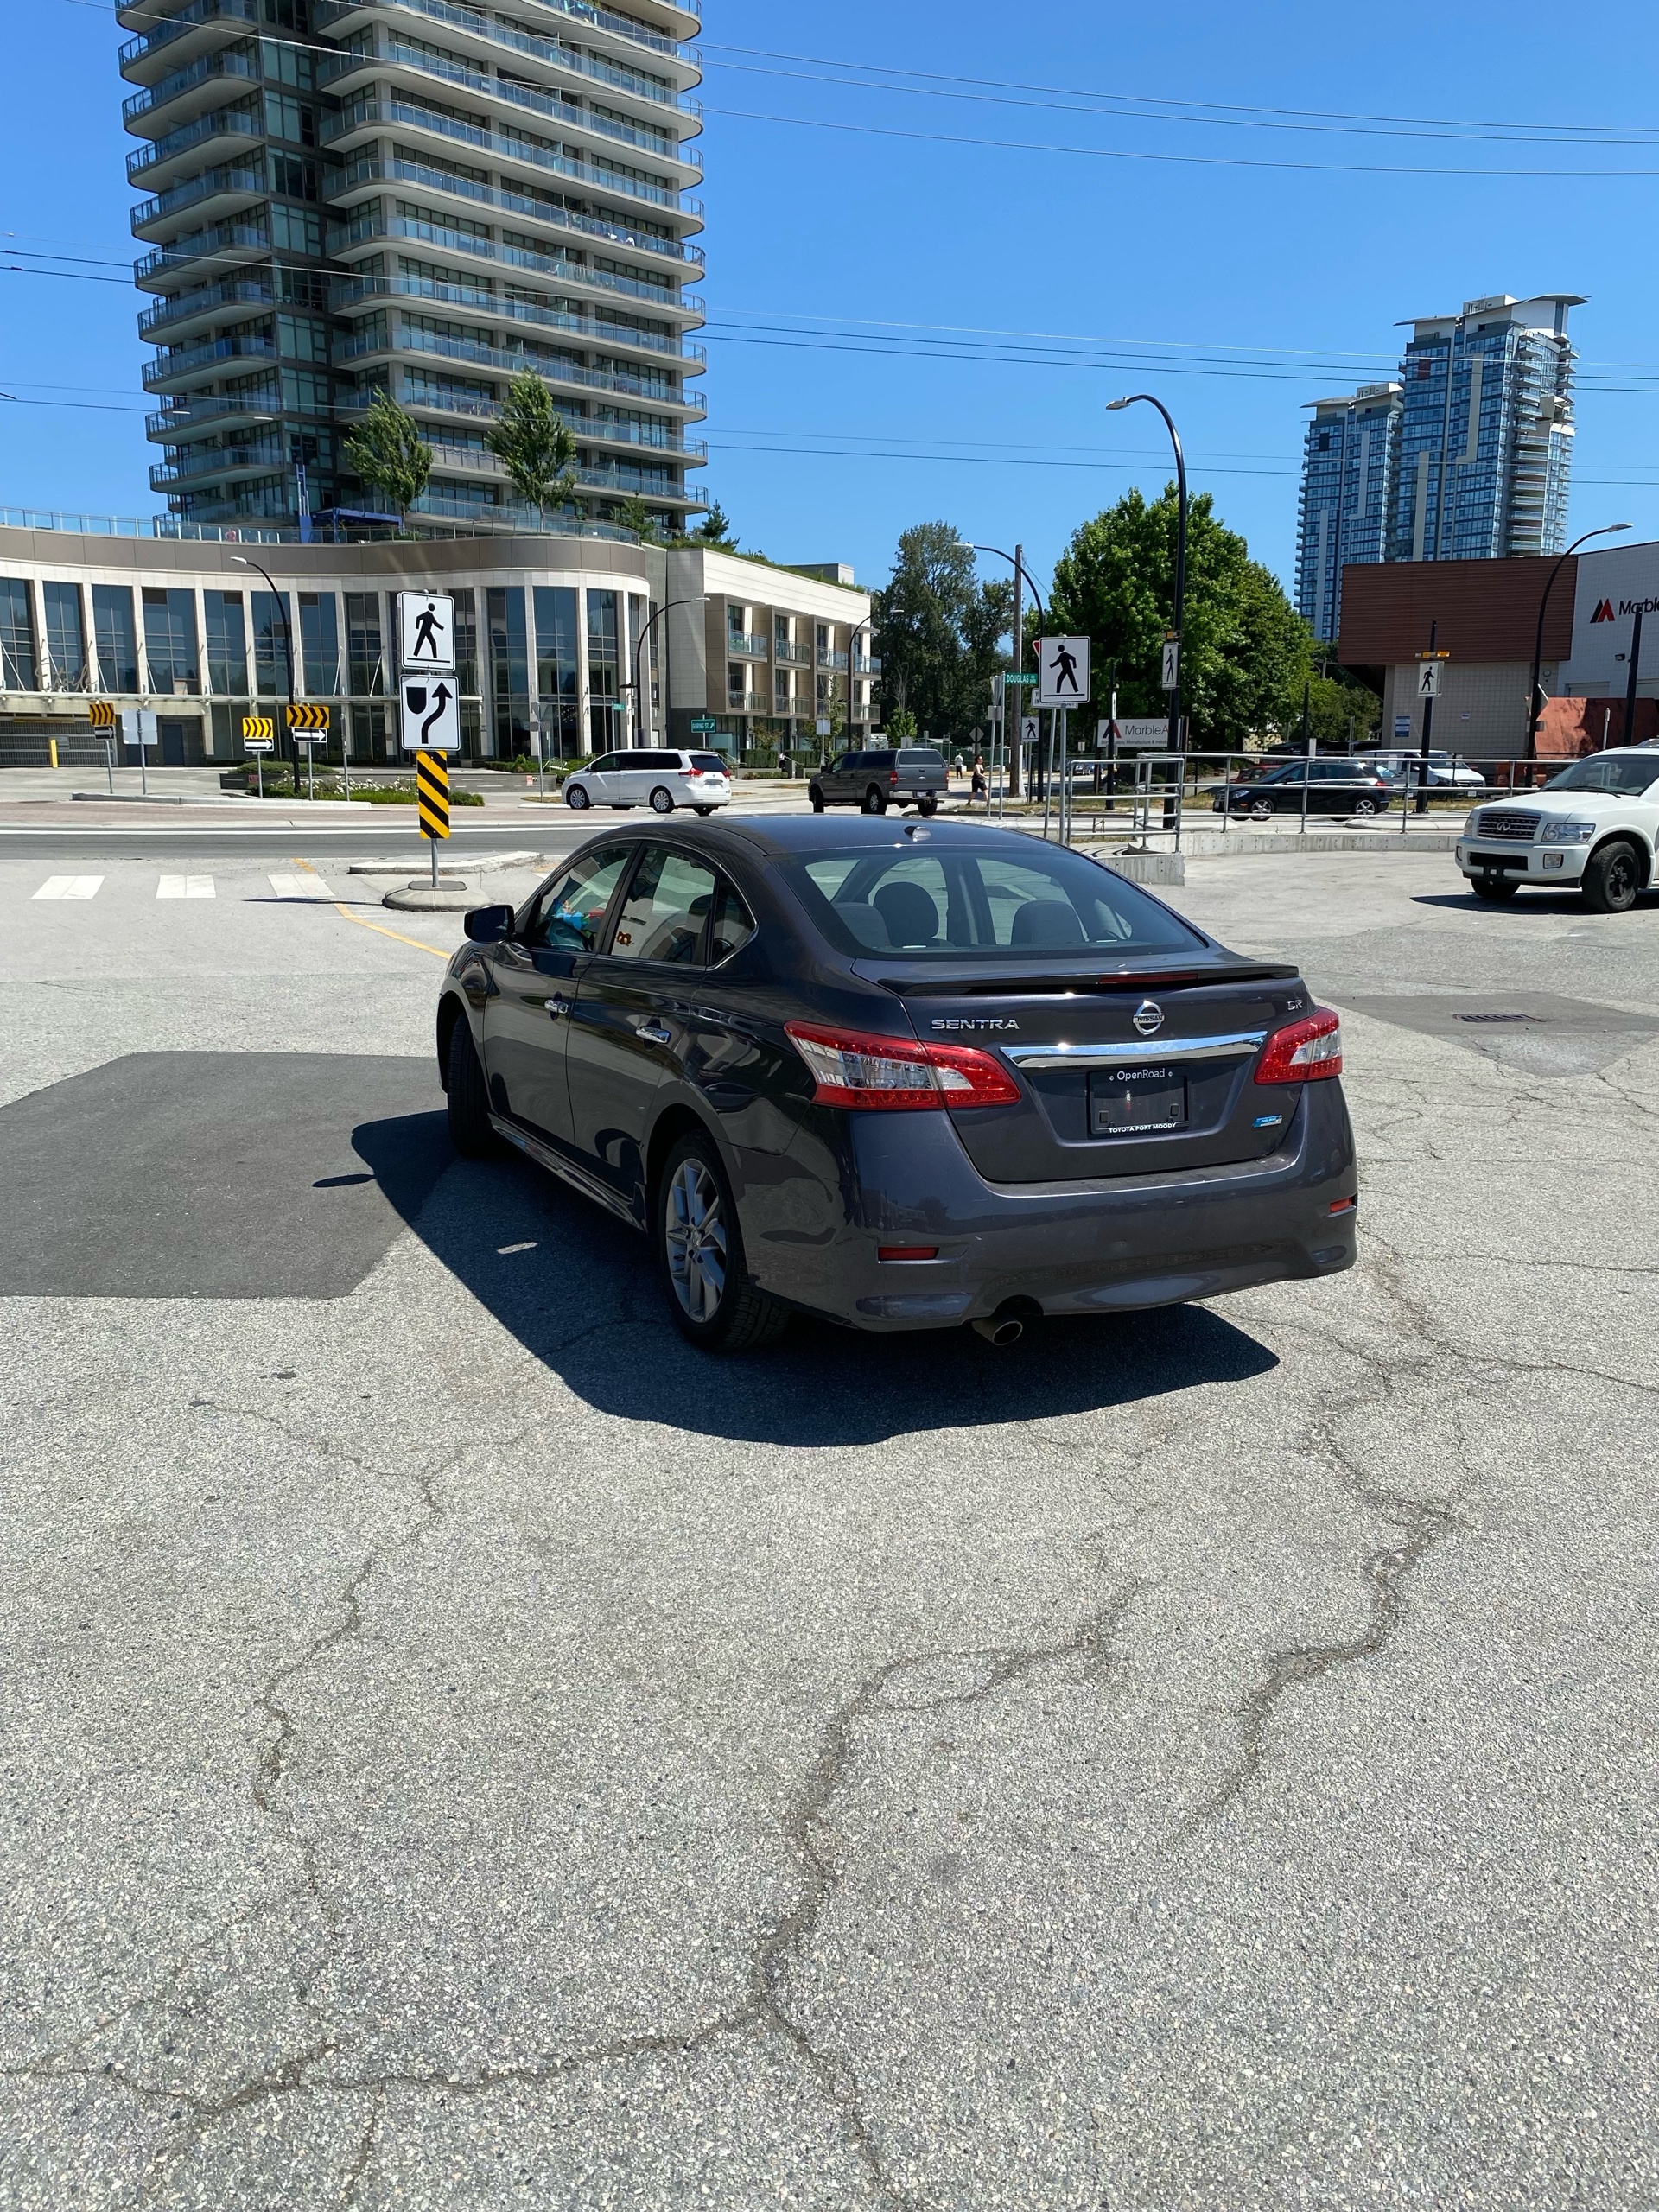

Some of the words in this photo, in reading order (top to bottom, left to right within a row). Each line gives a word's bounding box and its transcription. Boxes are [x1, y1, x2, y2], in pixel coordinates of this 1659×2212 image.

[1007, 674, 1029, 683] DOUGLAS
[1287, 999, 1303, 1011] SR
[931, 1019, 1020, 1030] SENTRA
[1116, 1068, 1166, 1082] OpenRoad
